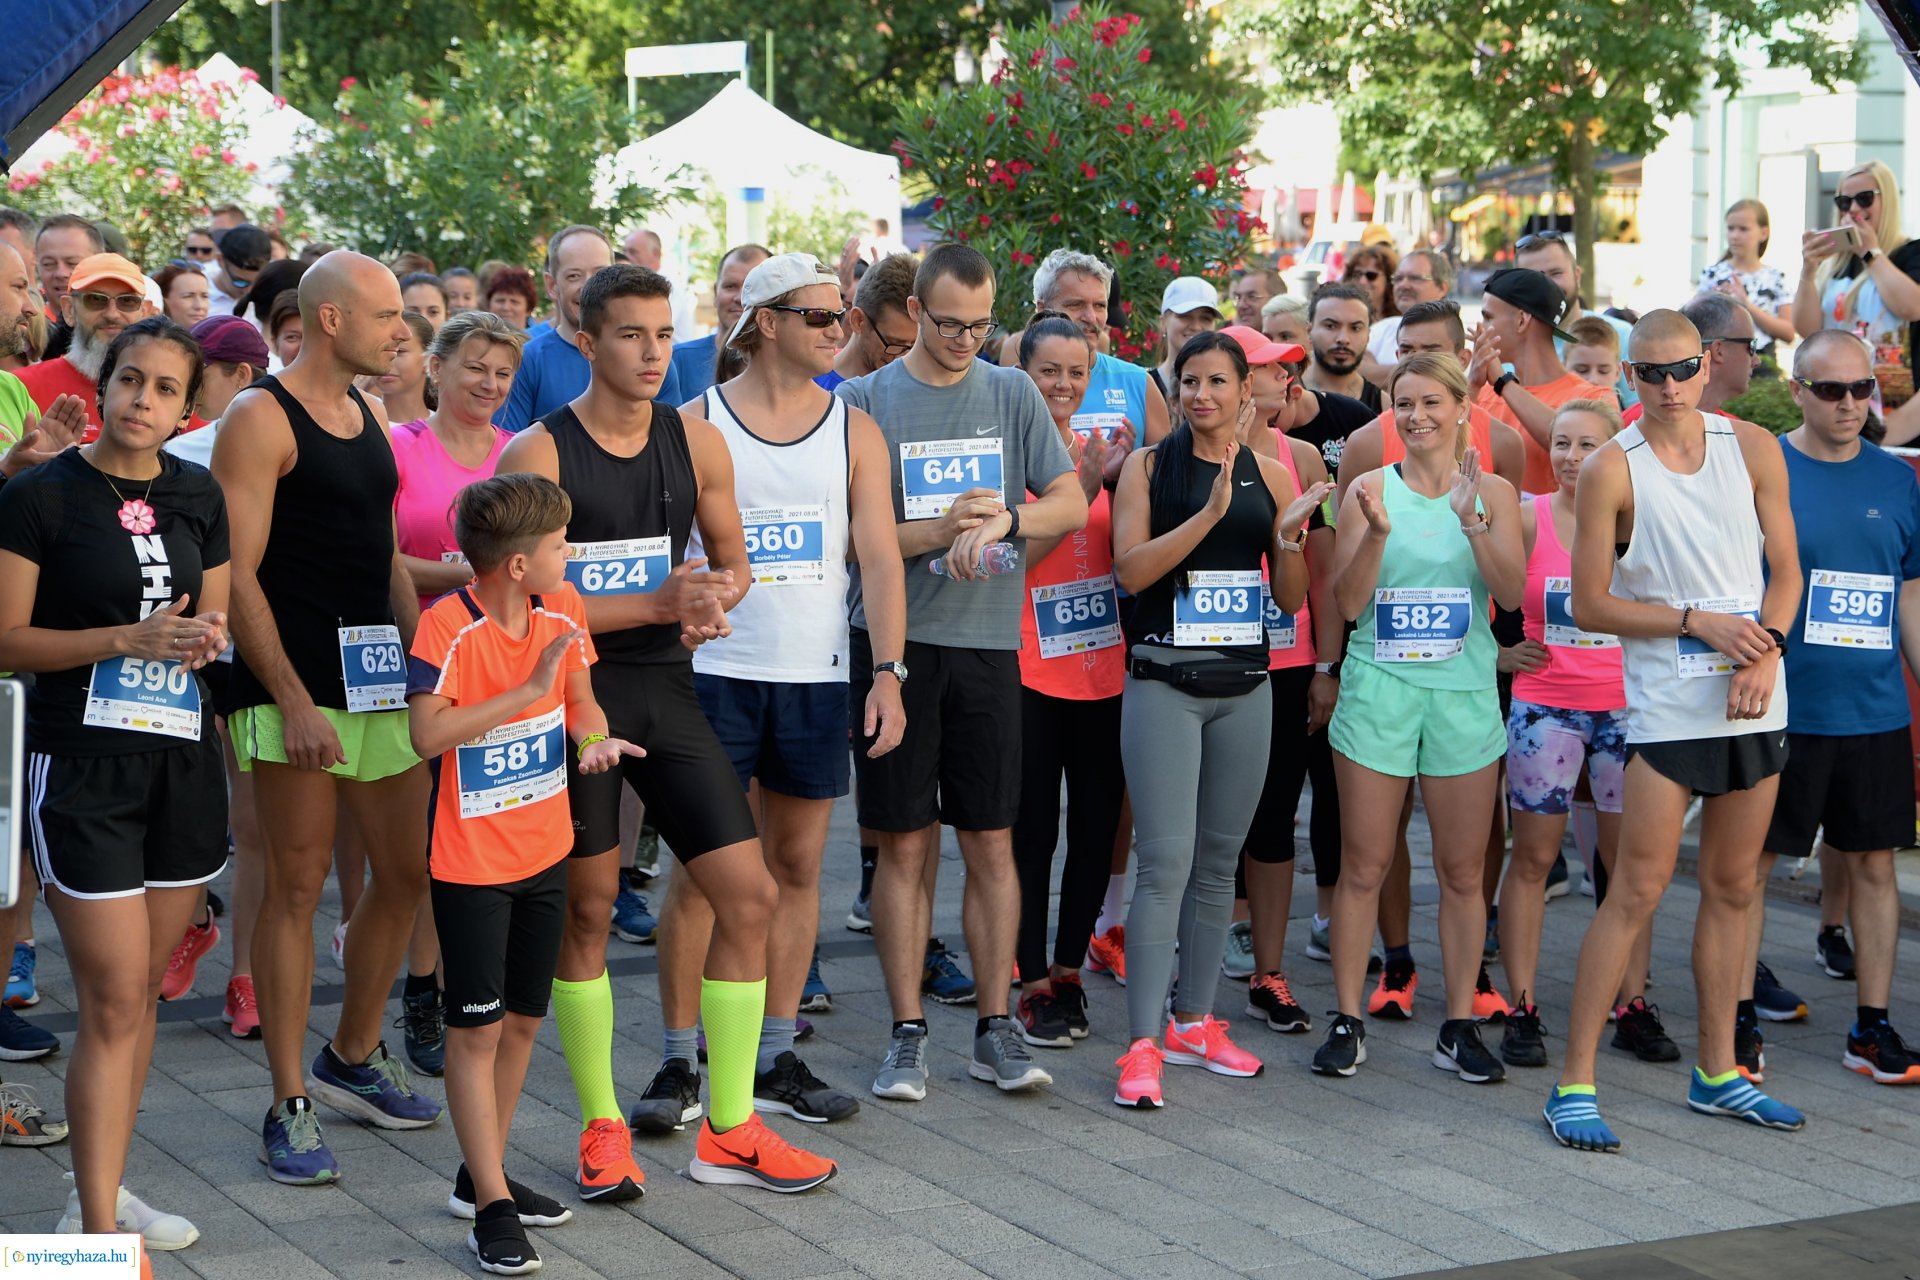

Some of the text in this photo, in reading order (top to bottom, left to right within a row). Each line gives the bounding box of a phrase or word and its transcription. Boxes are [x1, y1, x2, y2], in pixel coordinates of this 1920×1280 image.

[923, 457, 981, 485] 641
[743, 524, 804, 554] 560
[581, 559, 648, 592] 624
[1054, 594, 1107, 624] 656
[1194, 588, 1249, 613] 603
[1828, 590, 1883, 617] 596
[1391, 605, 1451, 630] 582
[361, 645, 401, 673] 629
[118, 657, 188, 695] 590
[483, 735, 547, 777] 581
[493, 767, 543, 786] Fazekas Zsombor
[462, 998, 501, 1014] uhlsport
